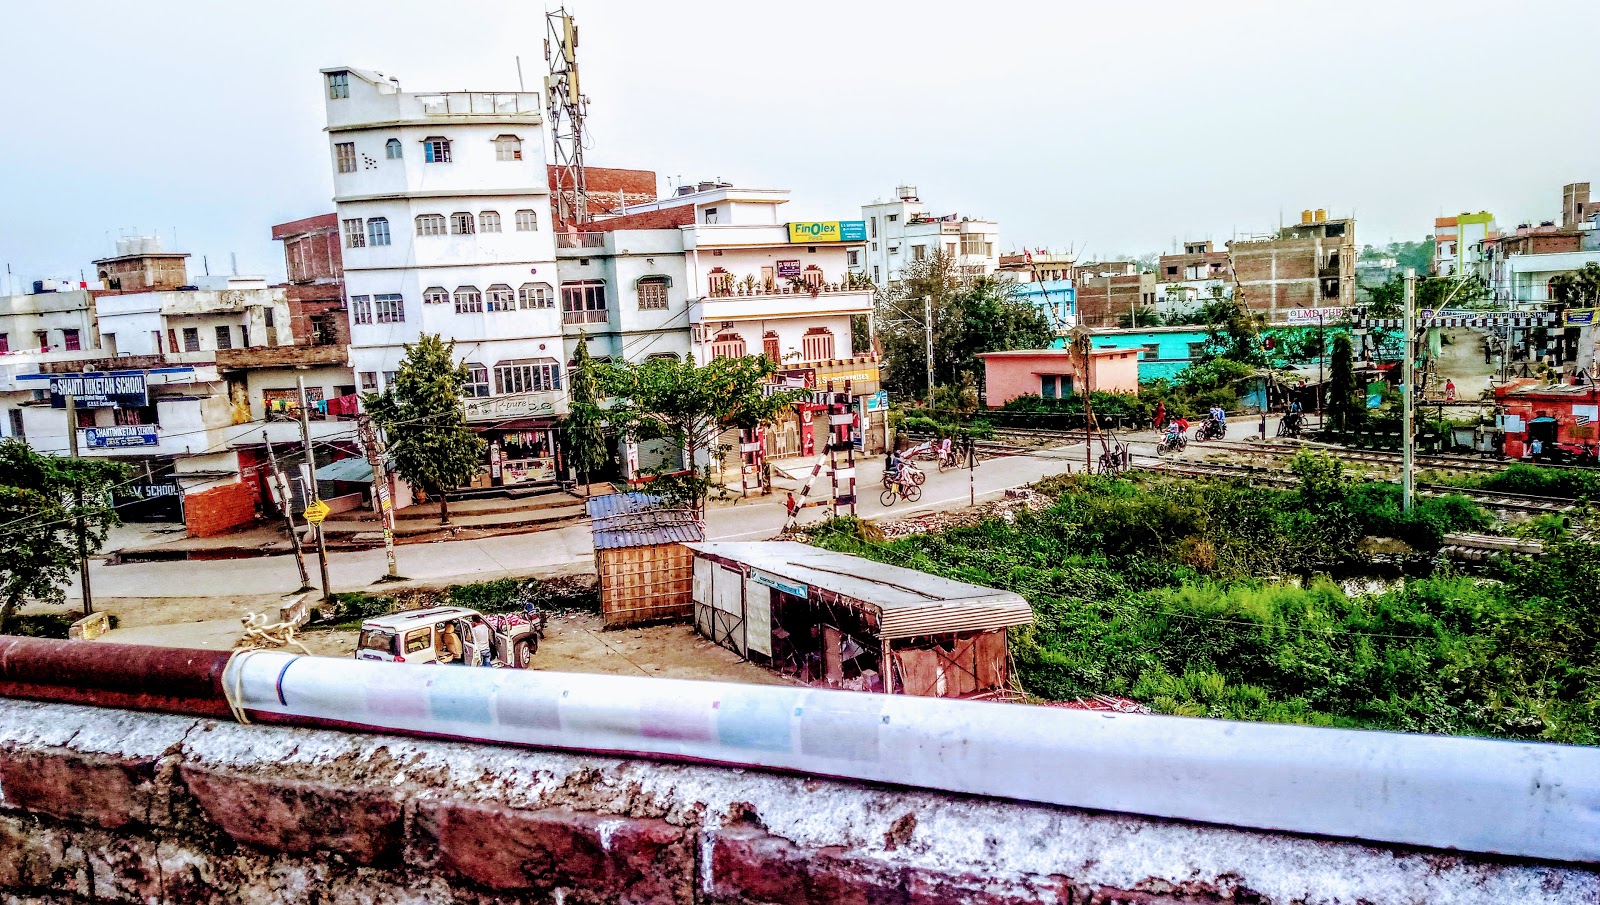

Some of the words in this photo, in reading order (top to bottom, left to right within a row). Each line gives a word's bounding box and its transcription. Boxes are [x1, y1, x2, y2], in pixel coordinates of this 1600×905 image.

[1297, 309, 1319, 318] LMD
[57, 378, 84, 395] SHANTI
[84, 377, 115, 395] NIKETAN
[115, 376, 145, 394] SCHOOL
[137, 426, 156, 436] SCHOOL
[145, 484, 179, 496] SCHOOL
